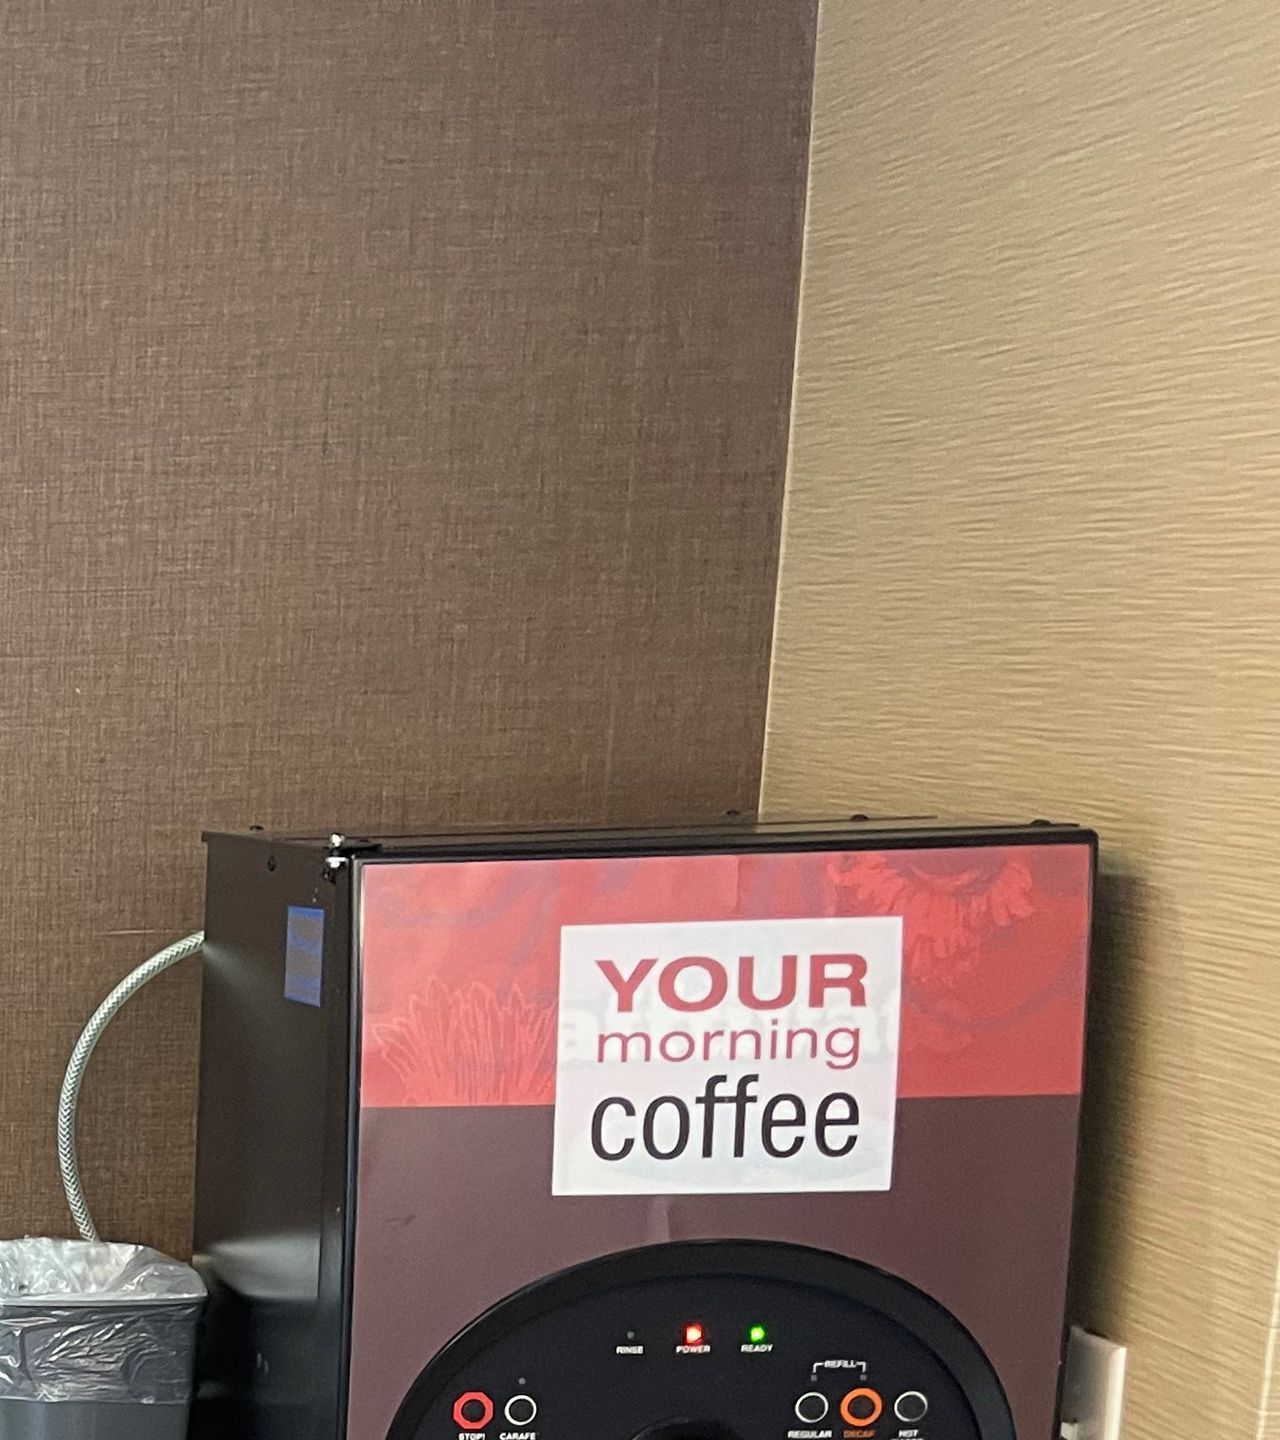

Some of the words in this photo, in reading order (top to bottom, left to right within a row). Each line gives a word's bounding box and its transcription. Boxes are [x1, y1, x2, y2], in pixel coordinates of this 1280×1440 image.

[595, 953, 868, 1013] YOUR
[597, 1019, 861, 1069] morning
[590, 1073, 860, 1161] coffee
[616, 1346, 644, 1354] RINSE
[676, 1345, 711, 1353] POWER
[740, 1344, 773, 1352] READY
[824, 1360, 856, 1368] REFILL
[458, 1433, 486, 1440] STOP!
[499, 1432, 536, 1440] CARAFE
[788, 1430, 832, 1438] REGULAR
[843, 1430, 876, 1438] DECAF
